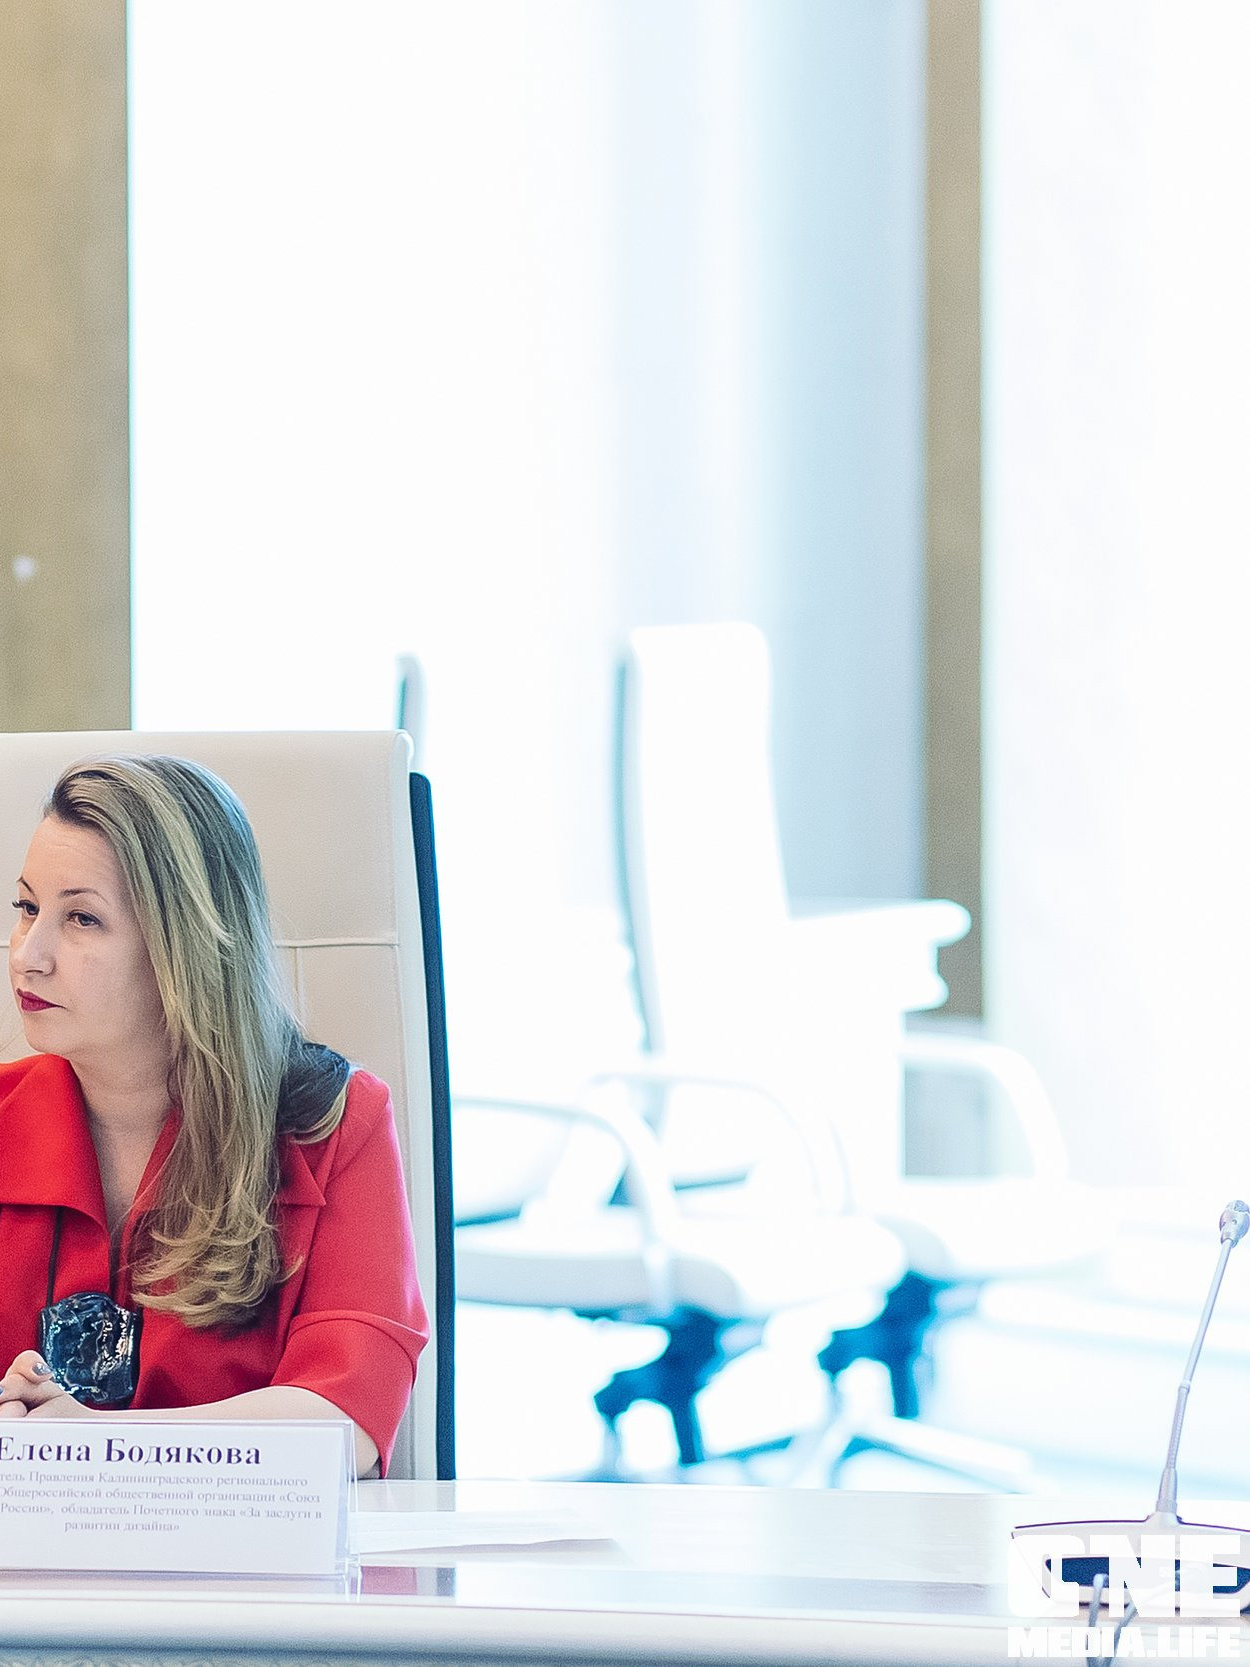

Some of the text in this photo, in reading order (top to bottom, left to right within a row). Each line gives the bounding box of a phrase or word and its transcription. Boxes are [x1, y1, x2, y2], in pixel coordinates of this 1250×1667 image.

[104, 1437, 261, 1467] Бодякова
[29, 1471, 95, 1484] Правления
[98, 1472, 214, 1487] Калининградского
[216, 1475, 308, 1488] регионального
[105, 1487, 194, 1501] общественной
[197, 1491, 276, 1503] организации
[279, 1491, 321, 1503] «Союз
[0, 1502, 54, 1515] России»,
[61, 1503, 130, 1515] обладатель
[133, 1504, 199, 1518] Почетного
[203, 1507, 236, 1517] знака
[239, 1506, 261, 1518] «За
[265, 1509, 311, 1522] заслуги
[315, 1510, 322, 1519] в
[64, 1520, 180, 1532] развитии дизайна»
